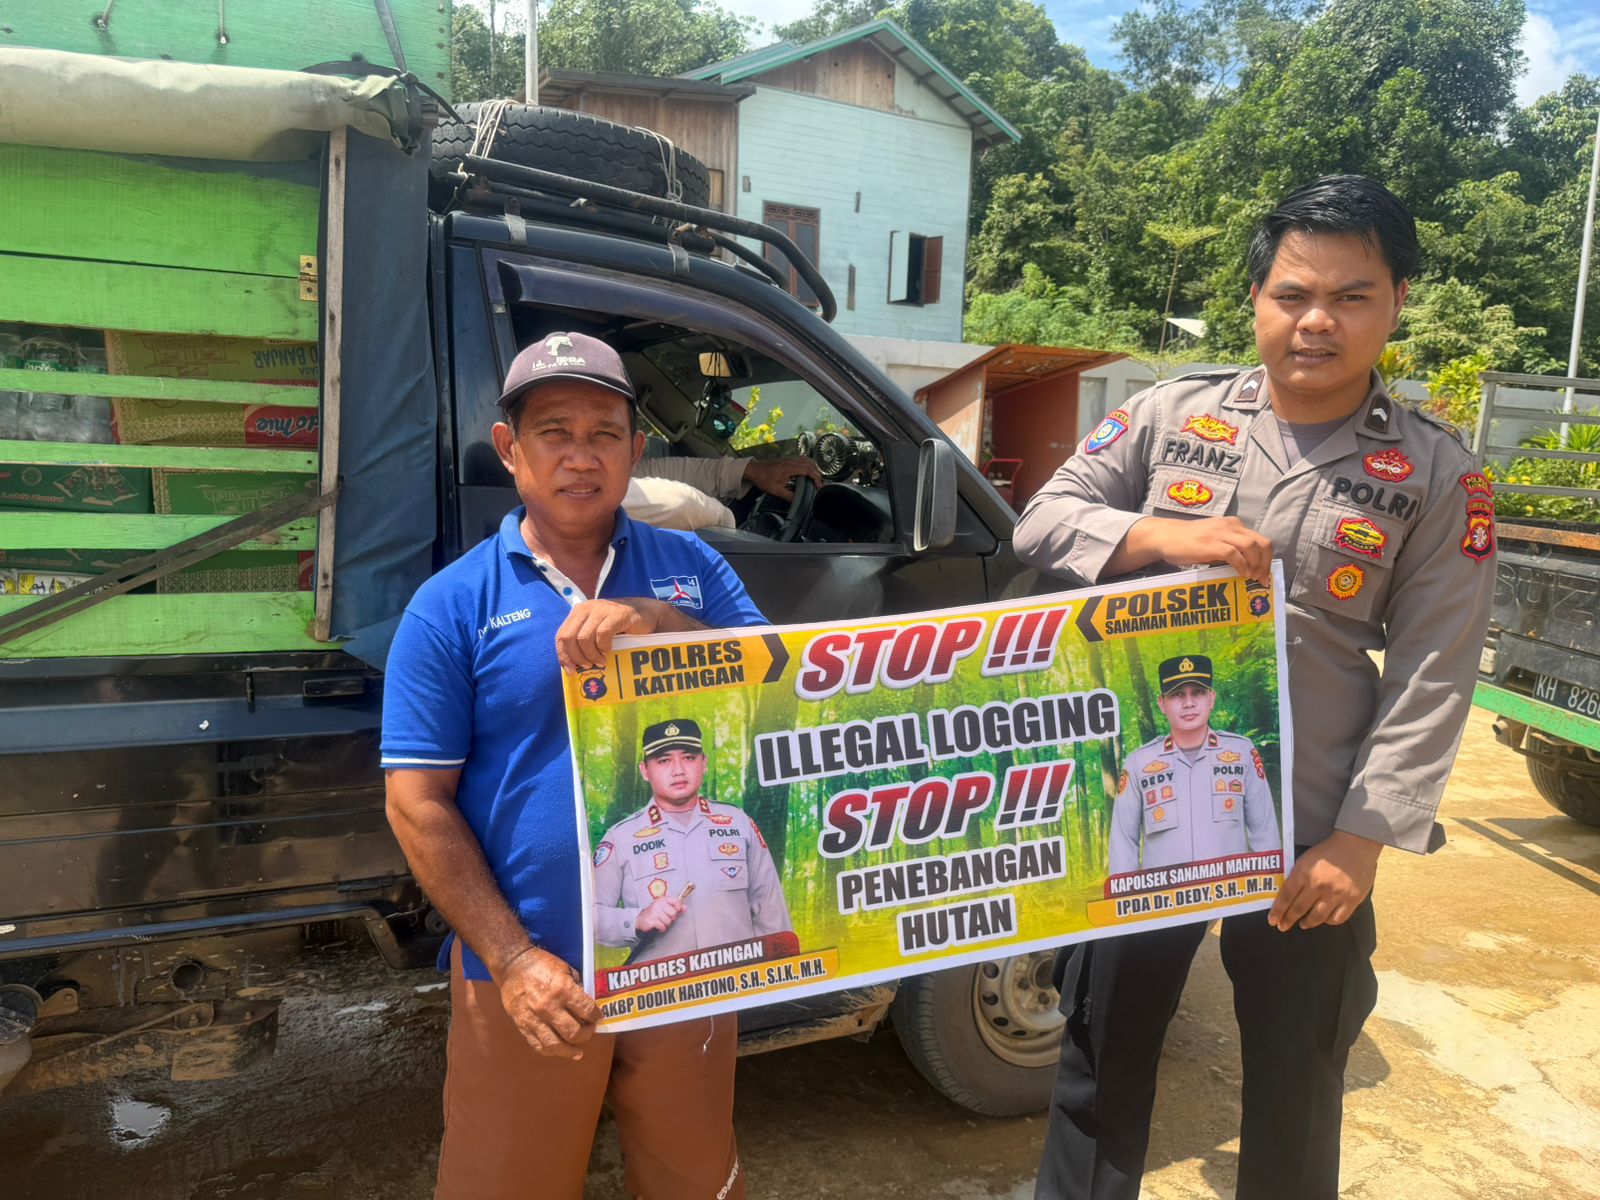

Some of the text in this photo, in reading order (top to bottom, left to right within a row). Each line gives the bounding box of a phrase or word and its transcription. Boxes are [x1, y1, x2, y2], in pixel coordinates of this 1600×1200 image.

[254, 346, 307, 369] BANJAR
[1161, 436, 1242, 473] FRANZ
[1331, 476, 1418, 521] POLRI
[489, 608, 532, 630] KALTENG
[1106, 582, 1230, 620] POLSEK
[1105, 606, 1231, 635] SANAMAN MANTIKEI
[631, 640, 743, 675] POLRES
[801, 608, 1067, 693] STOP !!!
[634, 665, 745, 697] KATINGAN
[1536, 674, 1558, 701] KH
[759, 692, 1116, 782] ILLEGAL LOGGING
[1140, 772, 1175, 789] DEDY
[1213, 766, 1244, 776] POLRI
[822, 763, 1071, 855] STOP !!!
[633, 839, 666, 855] DODIK
[709, 829, 740, 838] POLRI
[841, 841, 1062, 909] PENEBANGAN
[1110, 854, 1280, 894] KAPOLSEK SANAMAN MANTIKEI
[1116, 877, 1277, 916] IPDA Dr. DEDY, S.H., M.H.
[901, 898, 1013, 951] HUTAN
[607, 941, 763, 991] KAPOLRES KATINGAN
[601, 959, 826, 1018] AKBP DODIK HARTONO, S.H., S.I.K., M.H.
